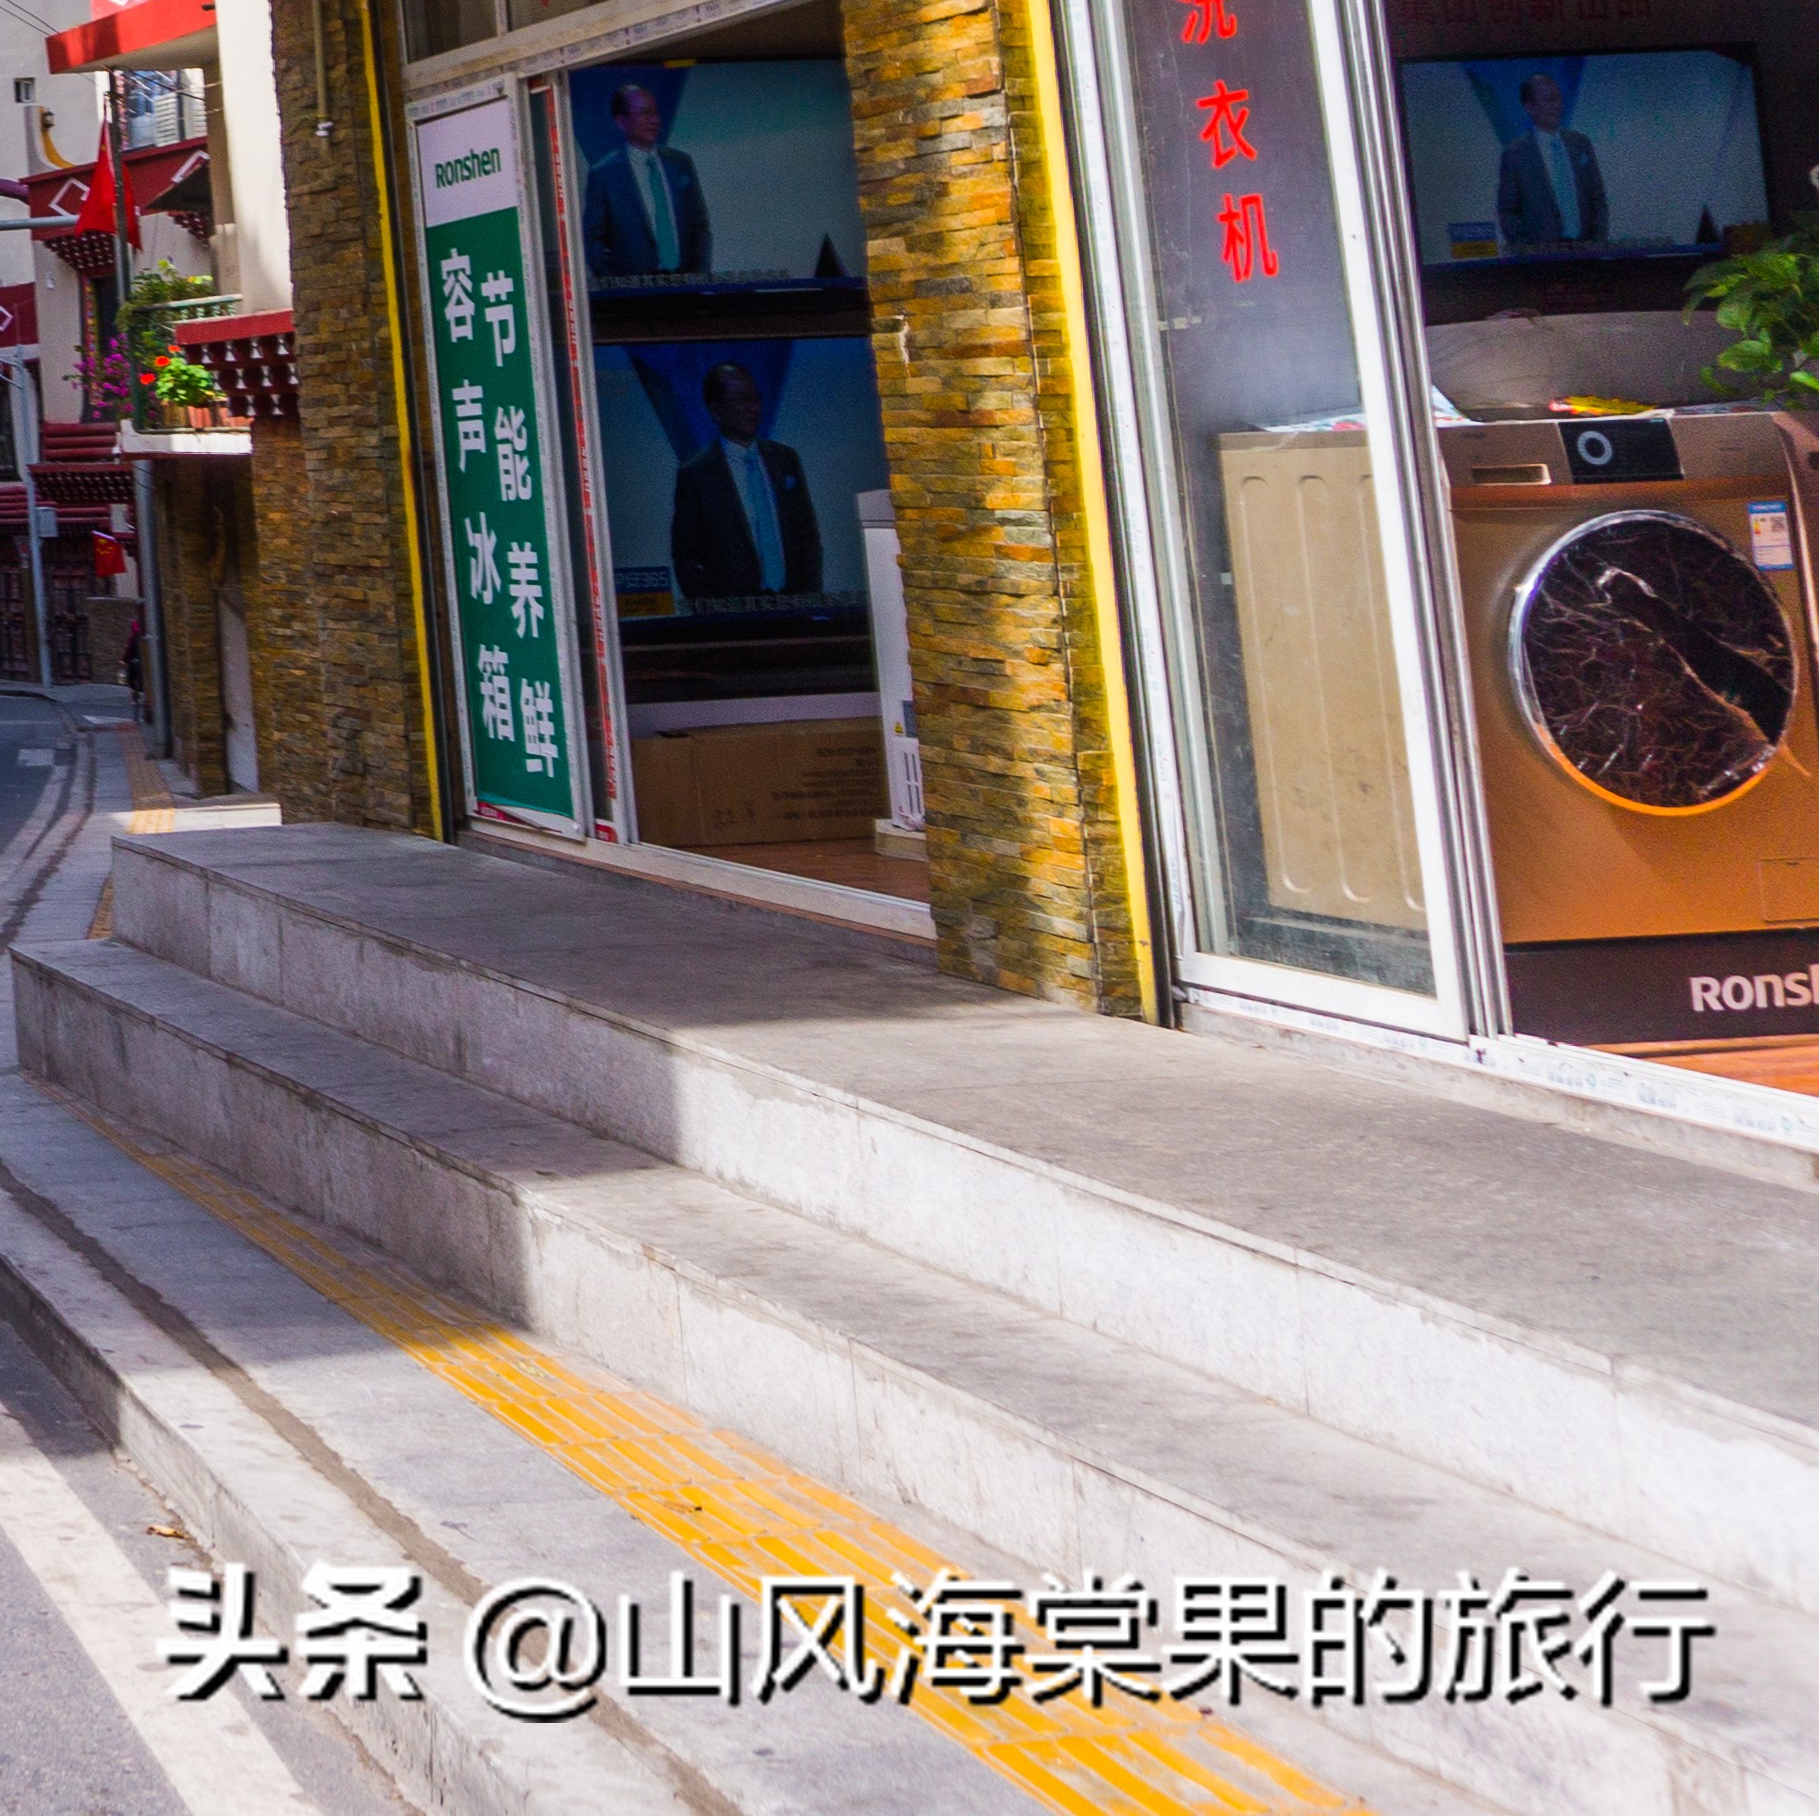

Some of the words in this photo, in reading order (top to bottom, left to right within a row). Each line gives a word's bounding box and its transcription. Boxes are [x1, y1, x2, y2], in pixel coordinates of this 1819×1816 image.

[441, 247, 517, 746] 容声冰箱
[479, 269, 559, 779] 节能养鲜
